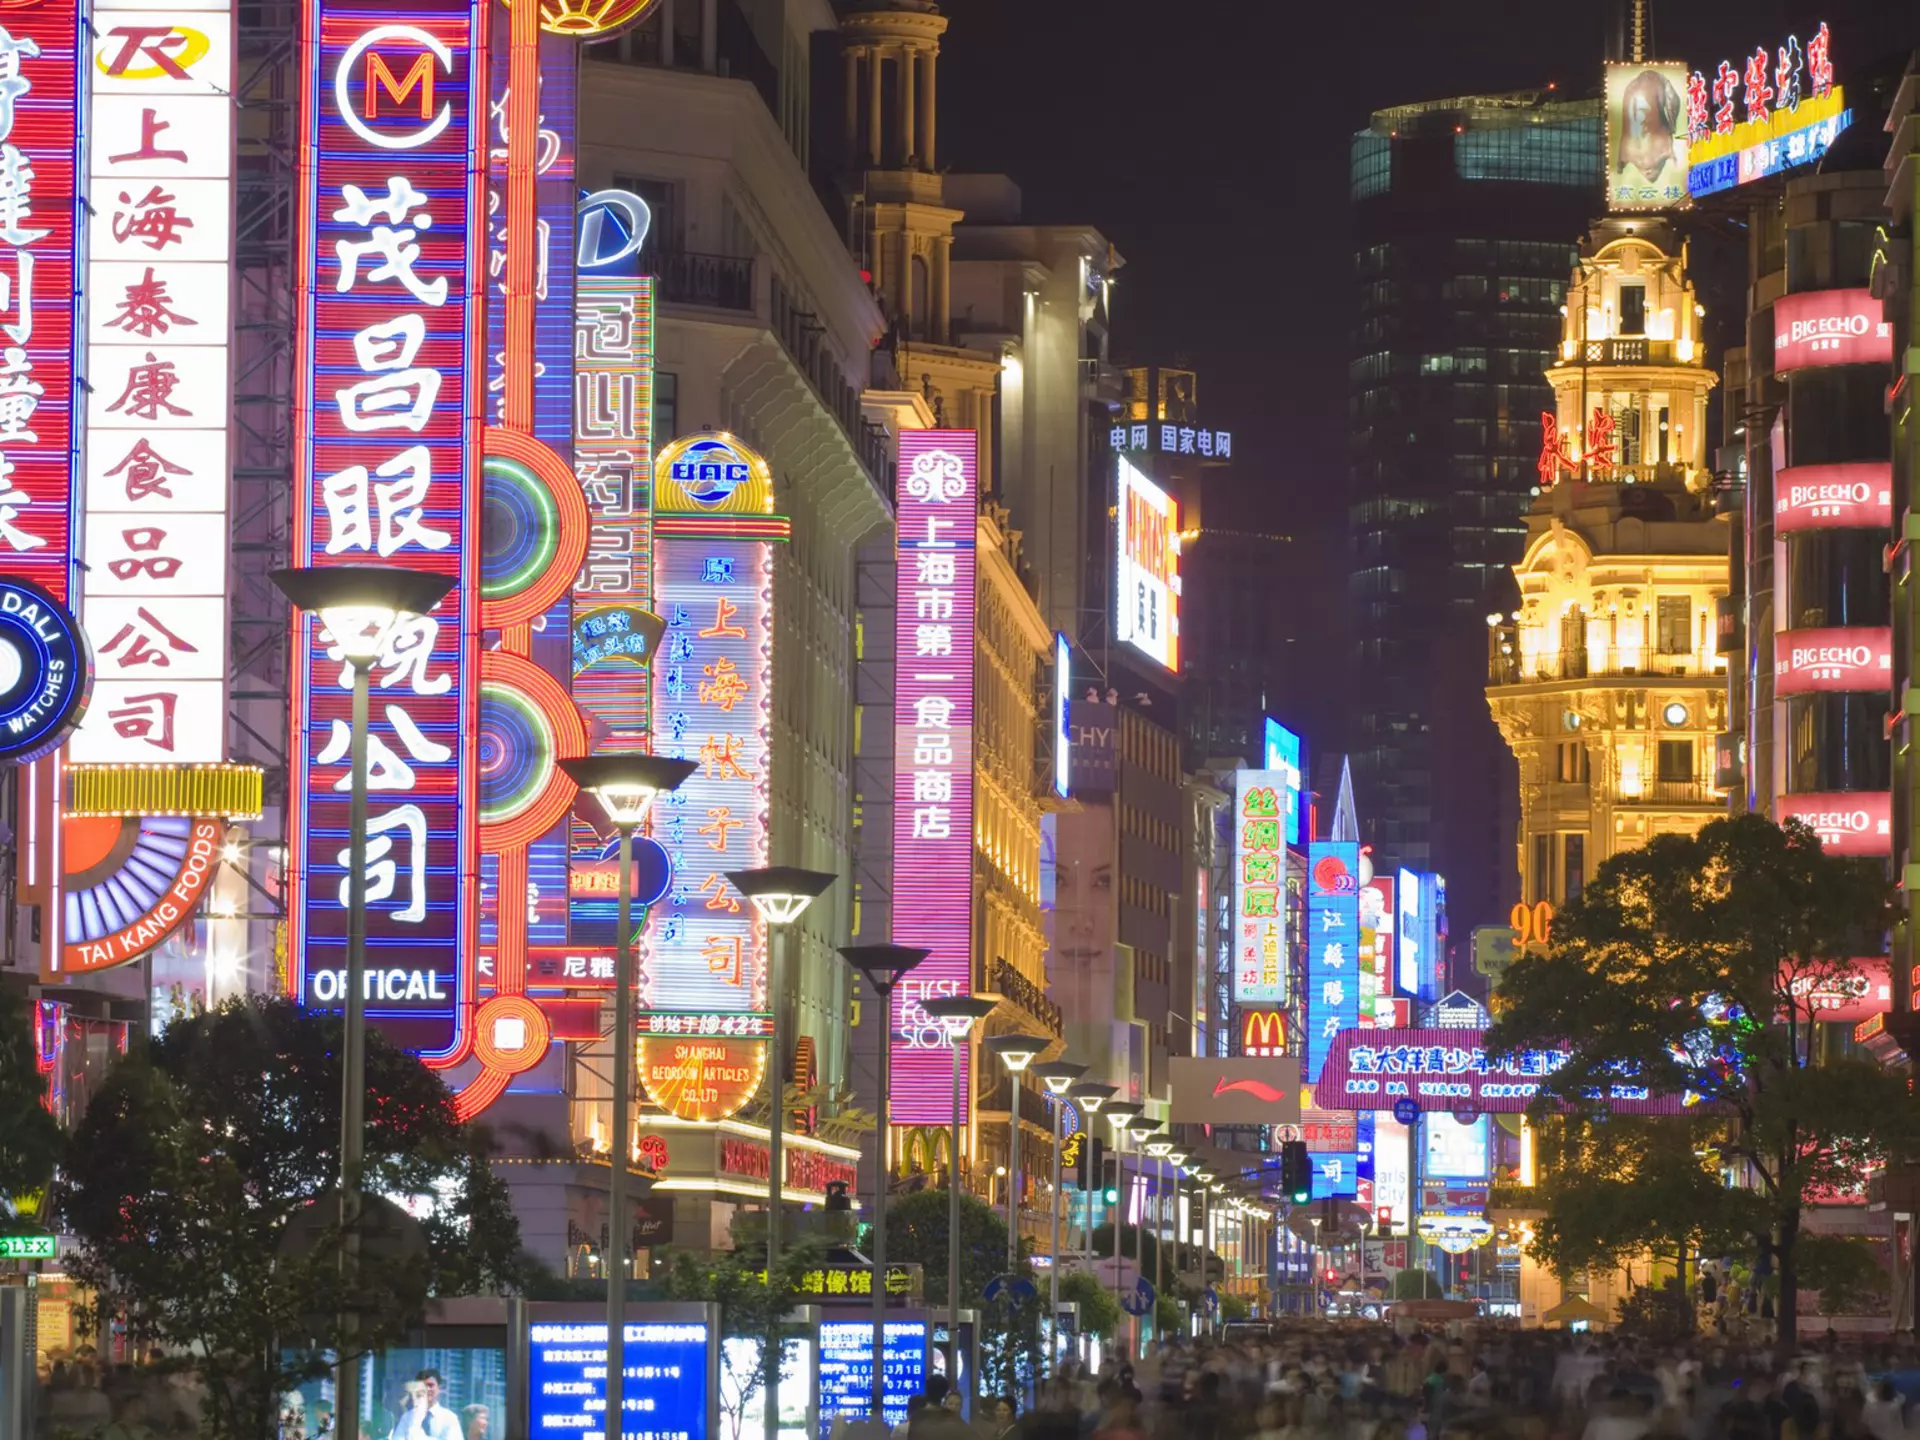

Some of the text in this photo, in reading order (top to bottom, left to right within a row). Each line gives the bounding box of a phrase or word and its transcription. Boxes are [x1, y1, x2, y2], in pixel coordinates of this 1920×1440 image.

[1791, 314, 1869, 341] BIG ECHO
[98, 108, 199, 752] 上海泰康食品公司
[1110, 425, 1232, 458] 电网 国家电网
[1791, 482, 1870, 507] BIG ECHO
[701, 557, 736, 583] 原
[3, 591, 61, 643] DALI
[1793, 645, 1871, 668] BIG ECHO
[912, 516, 957, 839] 上海市第一食品商店
[7, 658, 65, 735] WATCHES
[699, 596, 755, 987] 上海帳子公司
[1820, 811, 1869, 831] ECHO
[78, 824, 215, 966] TAI KANG FOODS
[1510, 901, 1553, 946] 90
[649, 1014, 764, 1035] 创始于1942年
[675, 1045, 726, 1061] SHANGHAI
[703, 1067, 750, 1082] ARTICLES
[1346, 1079, 1379, 1094] BAO
[1386, 1081, 1409, 1095] DA
[1418, 1082, 1471, 1097] XIANG
[1376, 1167, 1405, 1184] arls
[1378, 1186, 1405, 1205] City
[802, 1270, 872, 1294] 蜡像馆
